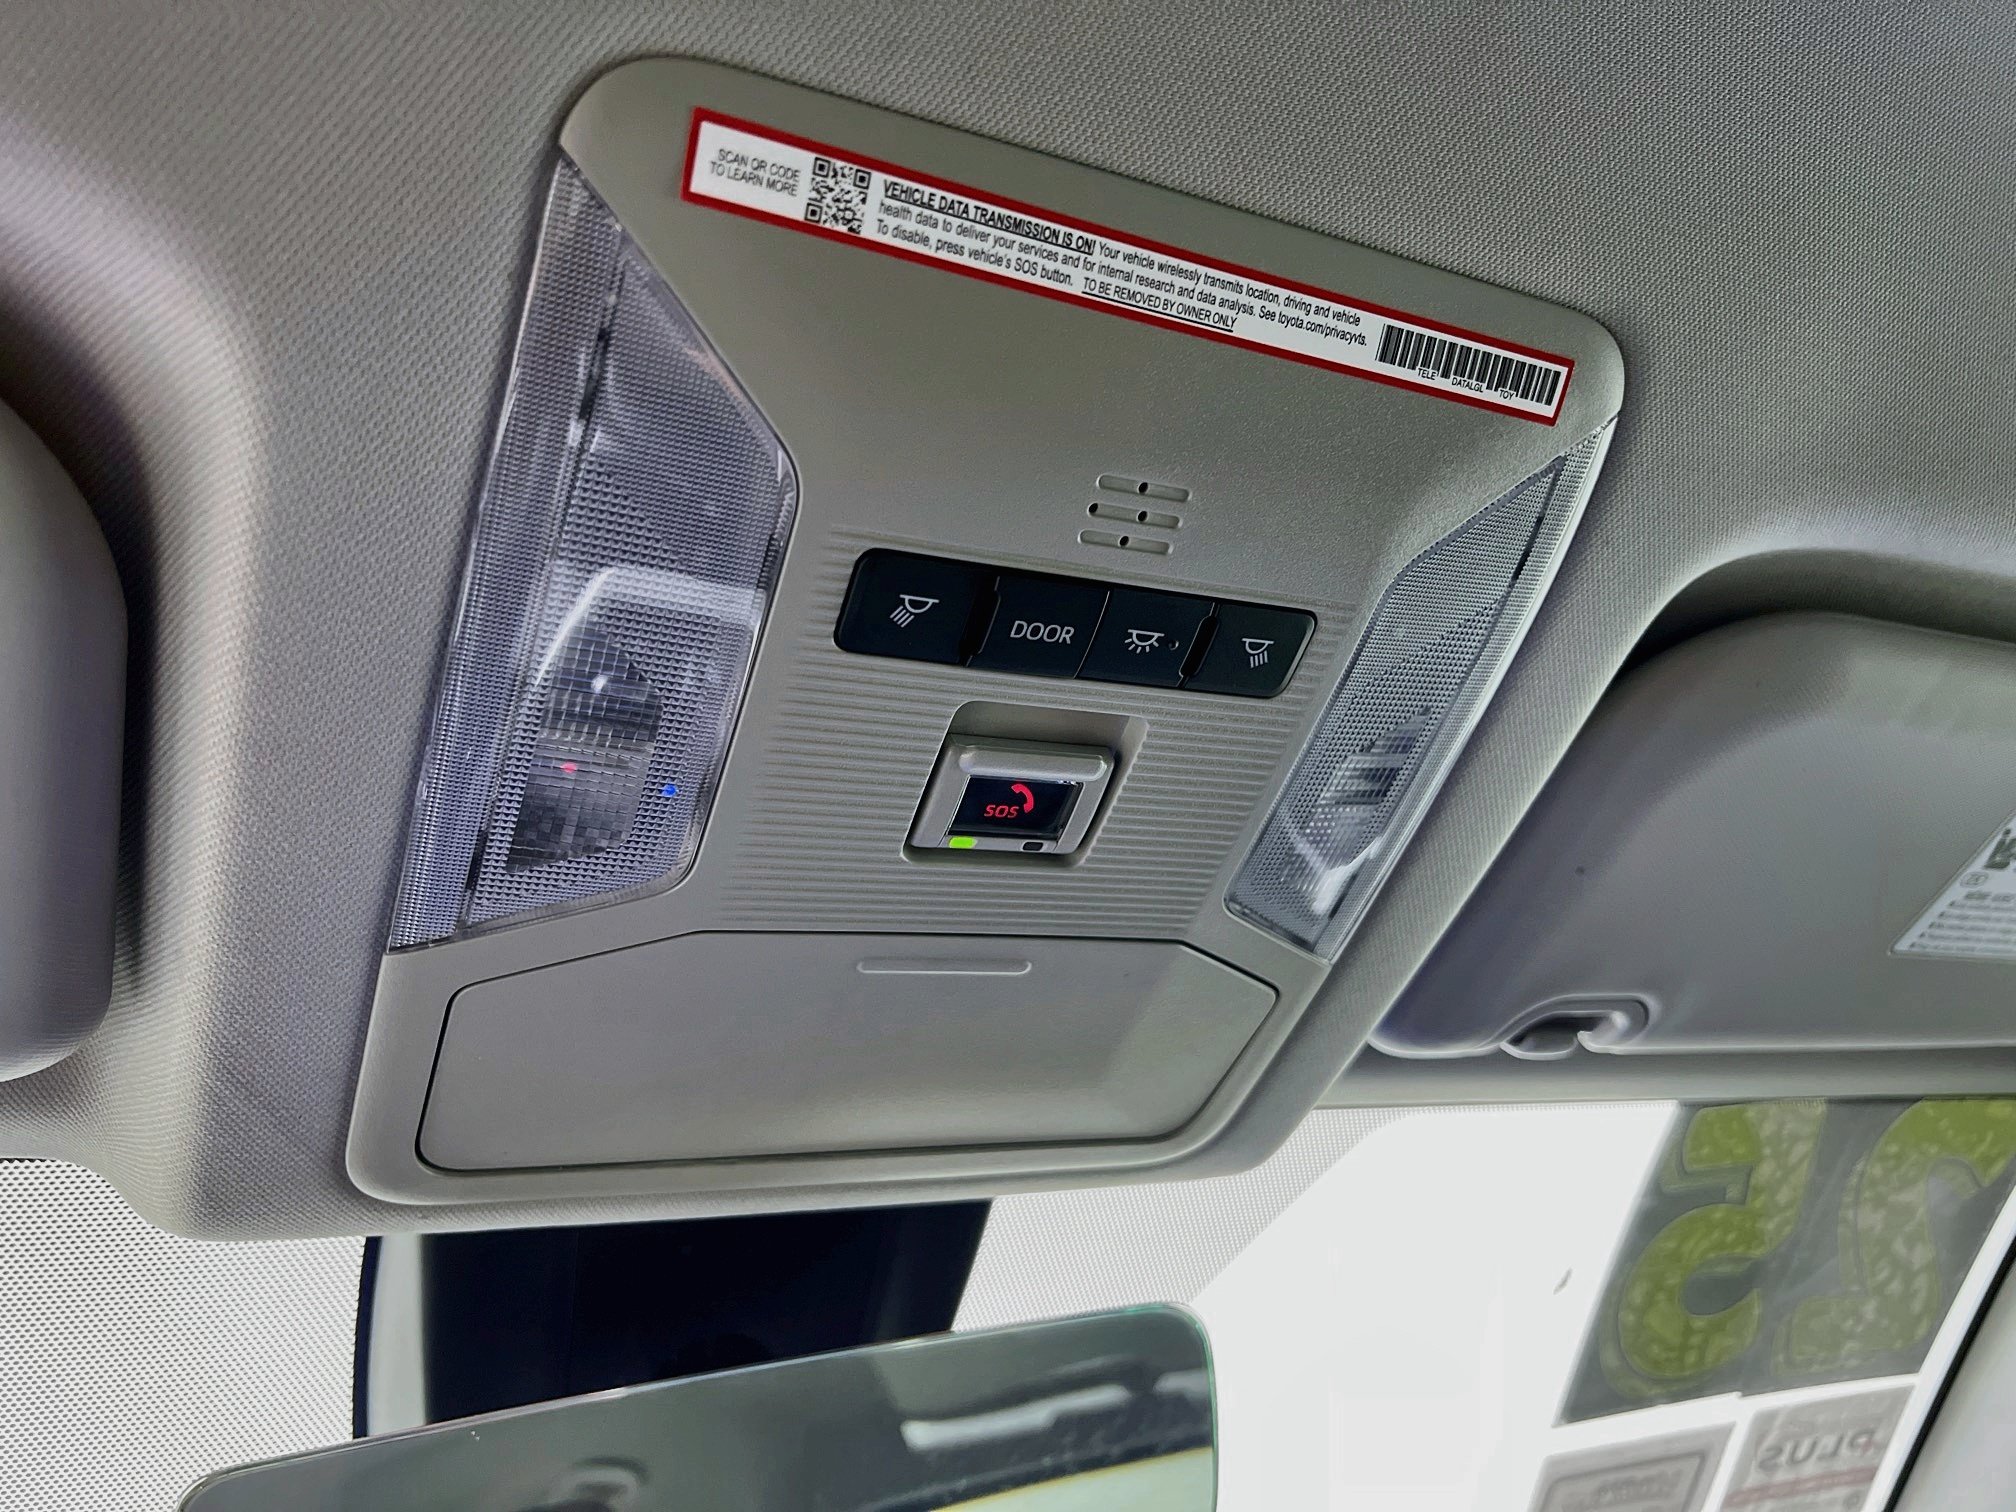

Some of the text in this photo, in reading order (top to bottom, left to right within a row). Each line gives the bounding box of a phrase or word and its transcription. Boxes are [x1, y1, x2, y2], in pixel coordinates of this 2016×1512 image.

[710, 161, 799, 197] TO LEARN MORE
[718, 149, 749, 167] SCAN
[770, 163, 800, 183] CODE
[878, 200, 912, 222] health
[915, 210, 939, 229] data
[942, 218, 952, 233] to
[956, 221, 991, 243] deliver
[992, 233, 1016, 251] your
[1017, 240, 1059, 263] services
[1061, 253, 1080, 268] and
[1082, 257, 1096, 272] for
[1098, 261, 1134, 283] internal
[1135, 274, 1175, 294] research
[1177, 284, 1195, 299] and
[1197, 288, 1217, 306] data
[1218, 295, 1256, 316] analysis.
[1259, 305, 1276, 322] See
[884, 179, 1361, 328] VEHICLE DATA TRANSMISSION IS ON! Your vehicle wirelessly transmits location, driving and vehicle
[876, 219, 1237, 328] To disable, press vehicle's SOS button. TO BE REMOVED BY OWNER ONLY
[1417, 368, 1436, 380] TELE
[1499, 389, 1515, 400] TOY
[1010, 619, 1075, 645] DOOR
[983, 803, 1020, 819] SOS
